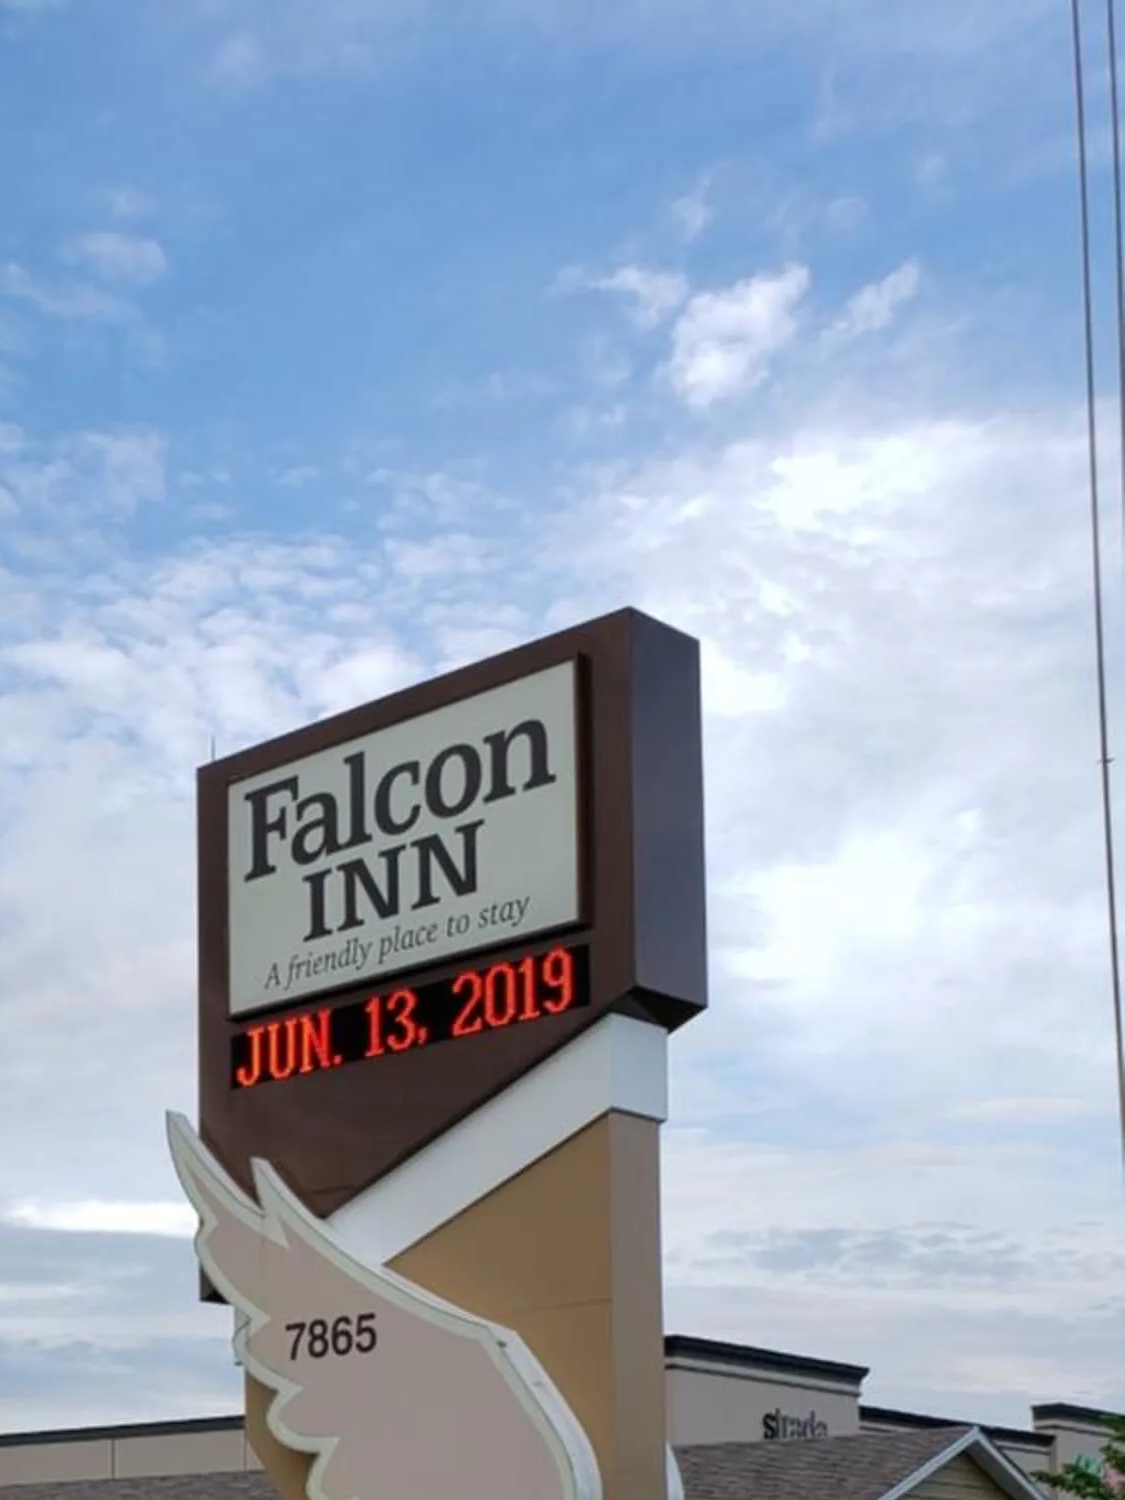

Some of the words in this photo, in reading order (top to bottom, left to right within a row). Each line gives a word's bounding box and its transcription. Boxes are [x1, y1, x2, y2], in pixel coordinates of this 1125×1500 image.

[243, 717, 557, 883] Falcon
[302, 818, 485, 943] INN
[263, 961, 282, 991] A
[283, 937, 374, 992] friendly
[377, 924, 439, 965] place
[445, 913, 471, 938] to
[477, 895, 531, 928] stay
[236, 1007, 343, 1087] JUN.
[451, 944, 575, 1038] 2019
[284, 1311, 378, 1361] 7865
